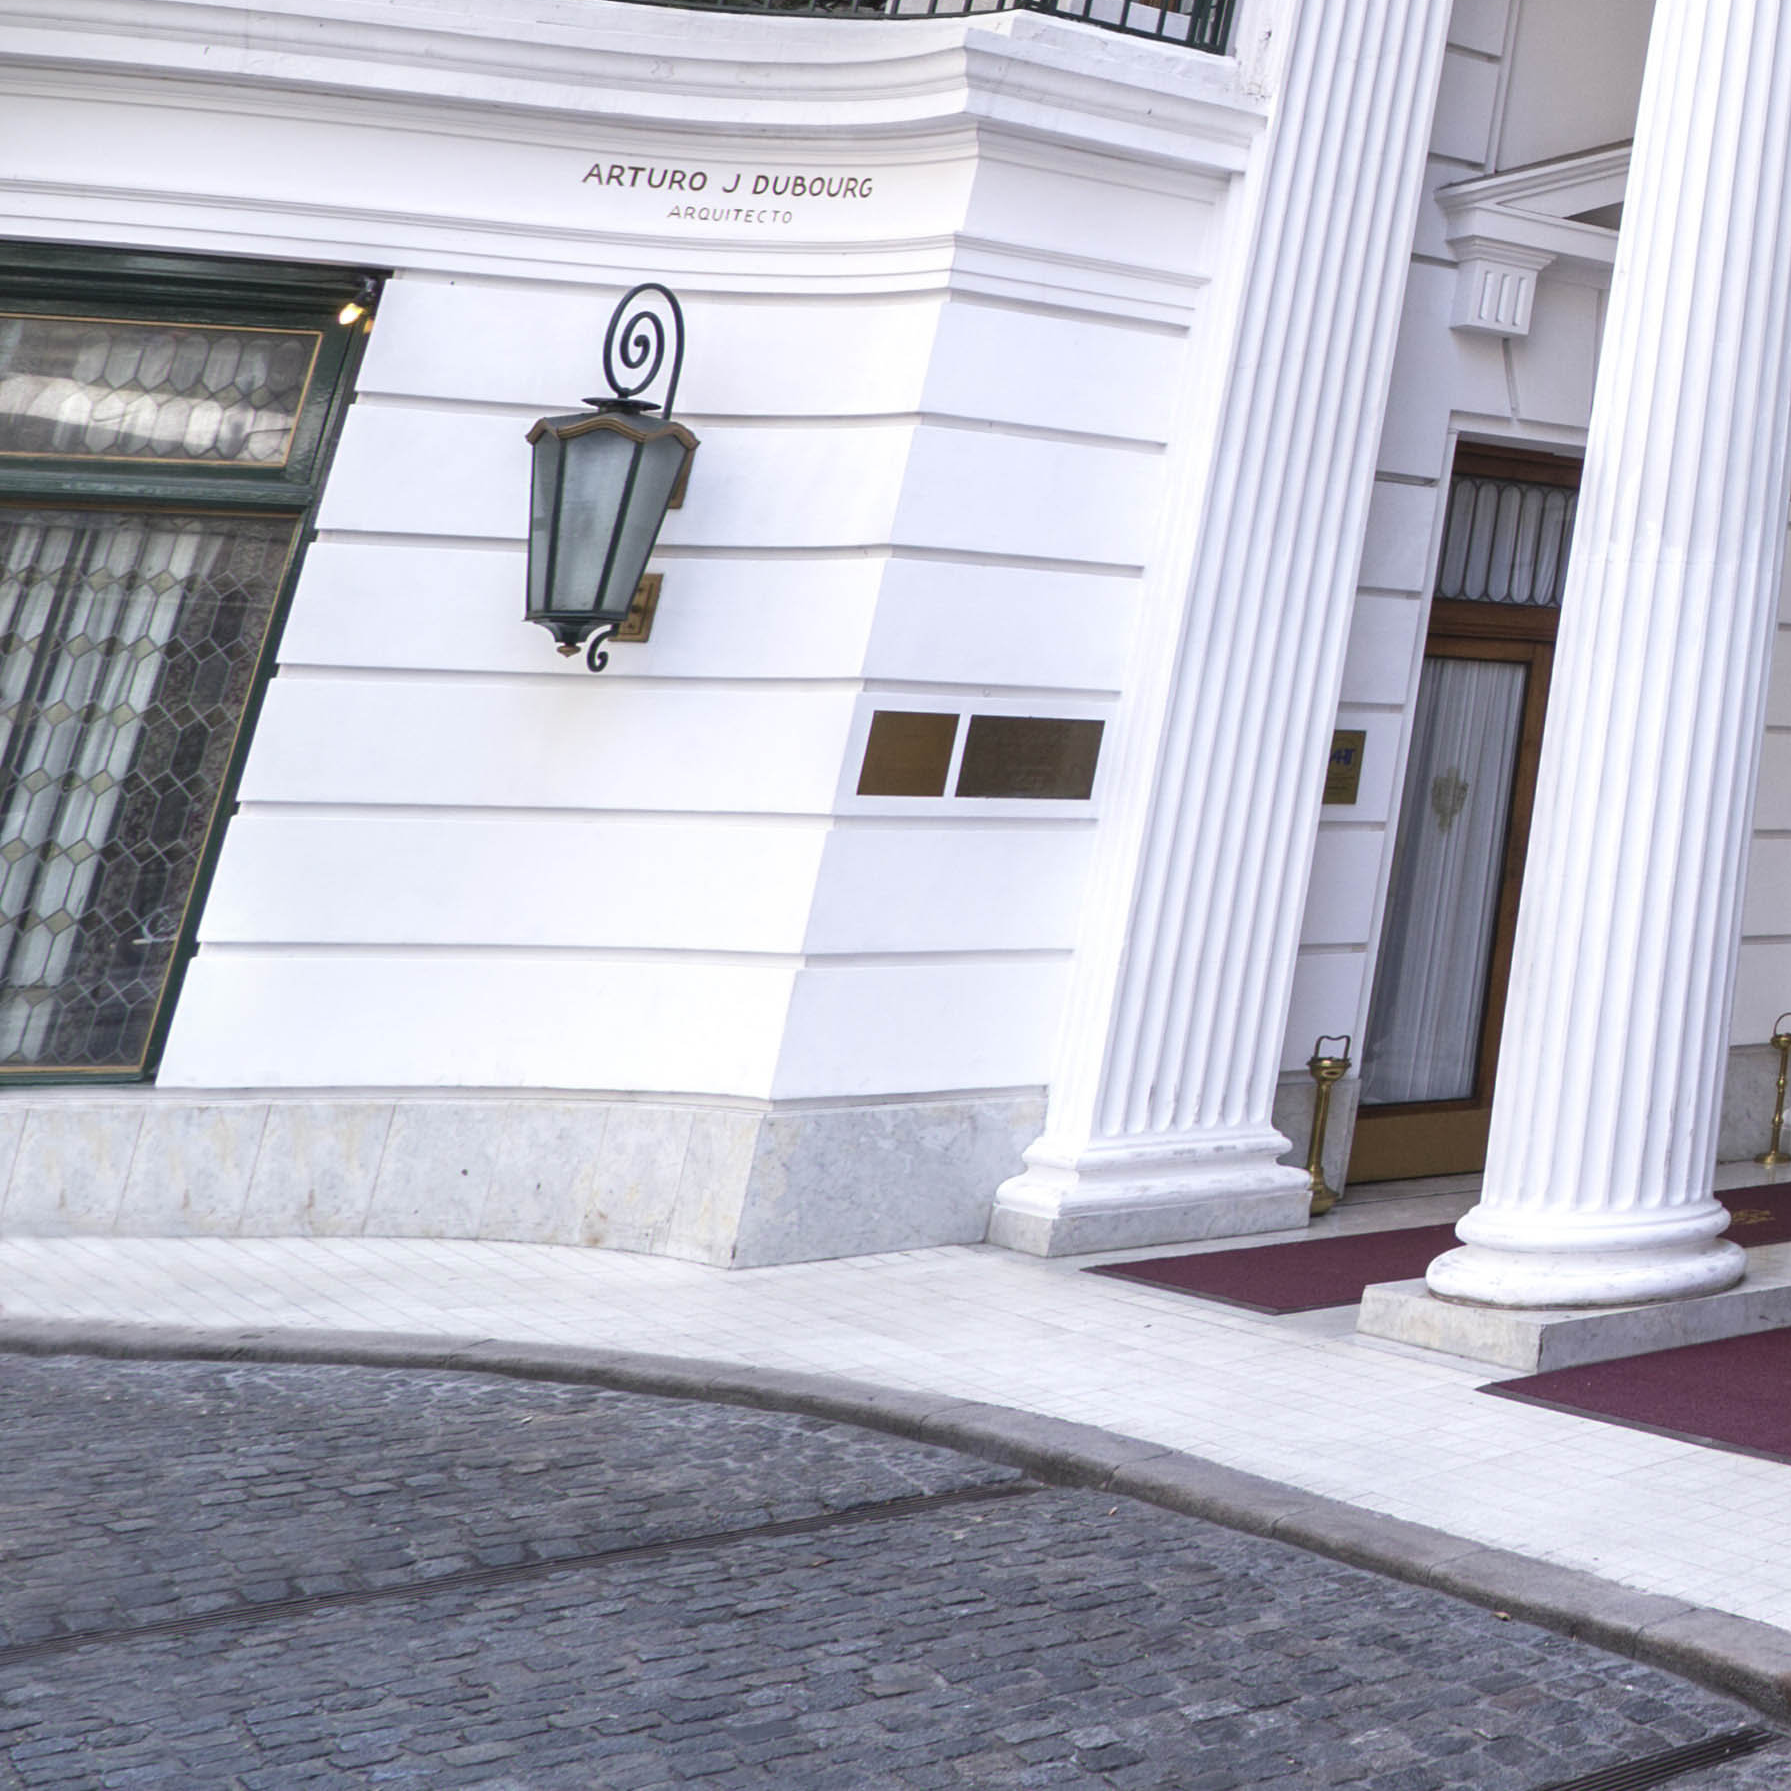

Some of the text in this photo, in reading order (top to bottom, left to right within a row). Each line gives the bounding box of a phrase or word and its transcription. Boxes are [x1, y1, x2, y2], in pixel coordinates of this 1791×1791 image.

[582, 162, 873, 199] ARTURO J DUBOURG
[667, 205, 793, 225] ARQUITECTO
